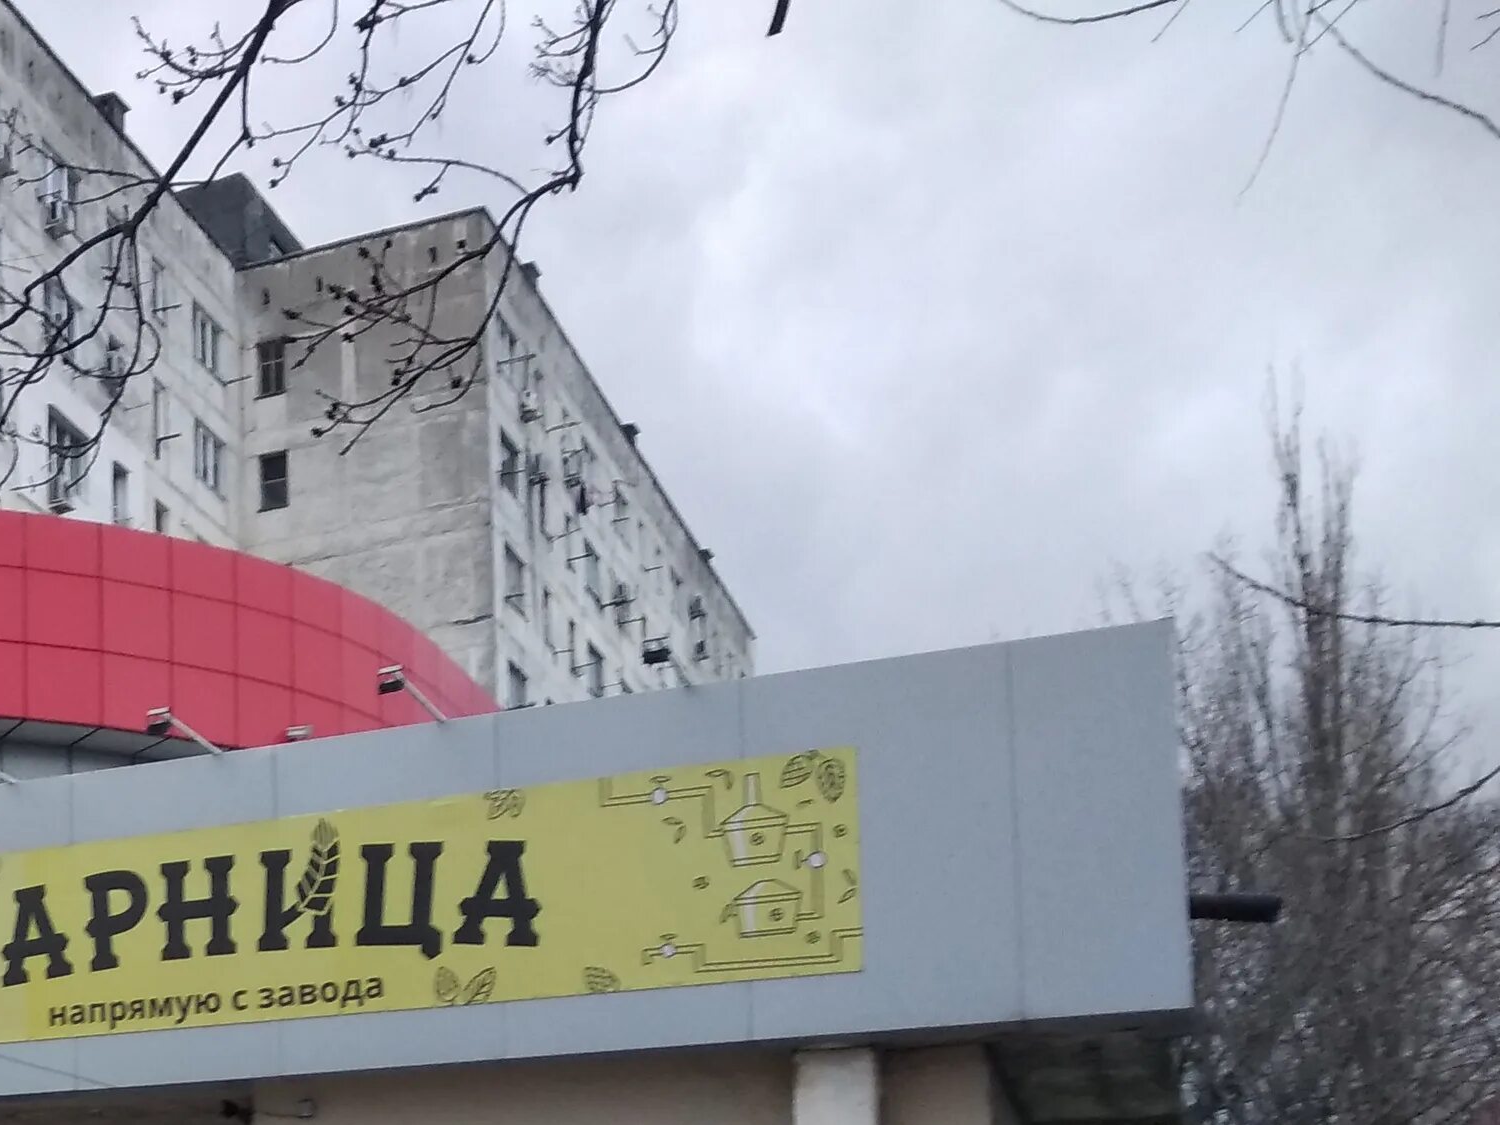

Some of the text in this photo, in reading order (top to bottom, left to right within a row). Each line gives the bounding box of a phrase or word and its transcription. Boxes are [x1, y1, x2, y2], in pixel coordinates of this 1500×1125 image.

[49, 976, 385, 1030] напрямую с завода
